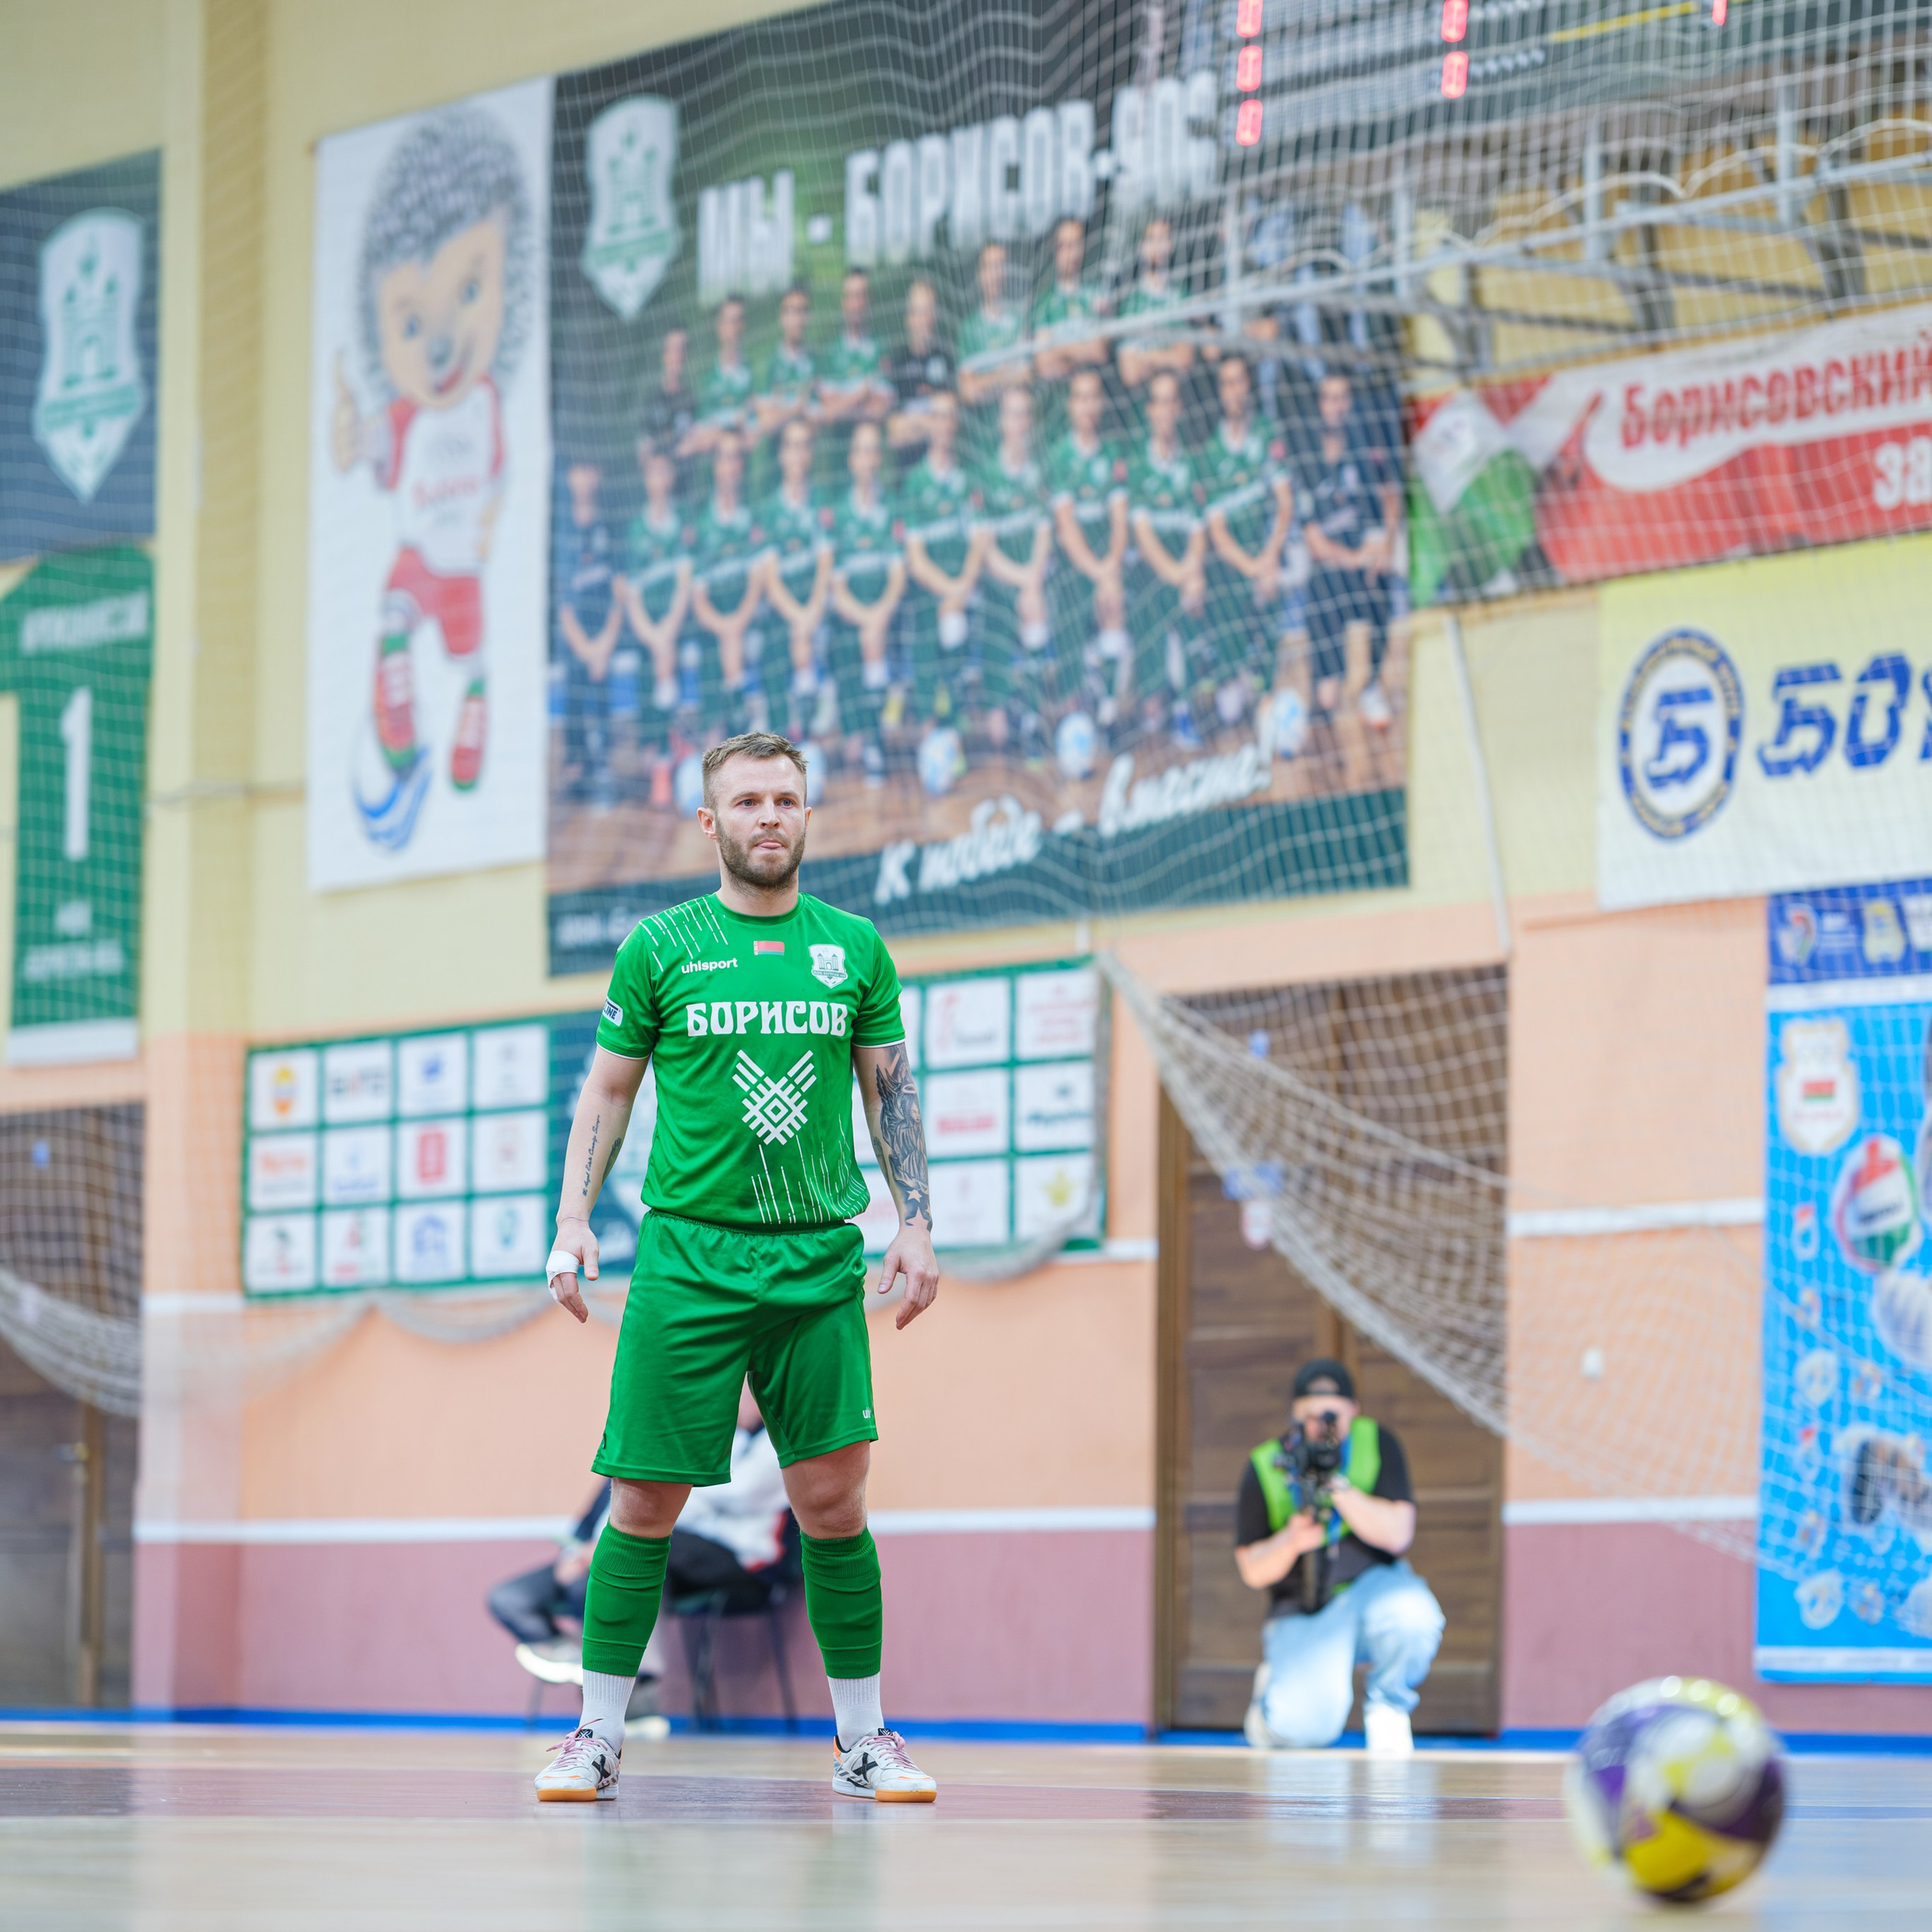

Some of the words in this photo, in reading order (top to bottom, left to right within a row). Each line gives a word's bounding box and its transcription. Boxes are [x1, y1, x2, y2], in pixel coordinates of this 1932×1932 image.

[1757, 654, 1932, 777] БО
[60, 685, 92, 860] 1
[681, 957, 738, 974] uhlsport
[604, 1005, 617, 1020] INE
[686, 1001, 849, 1038] БОРИСОВ
